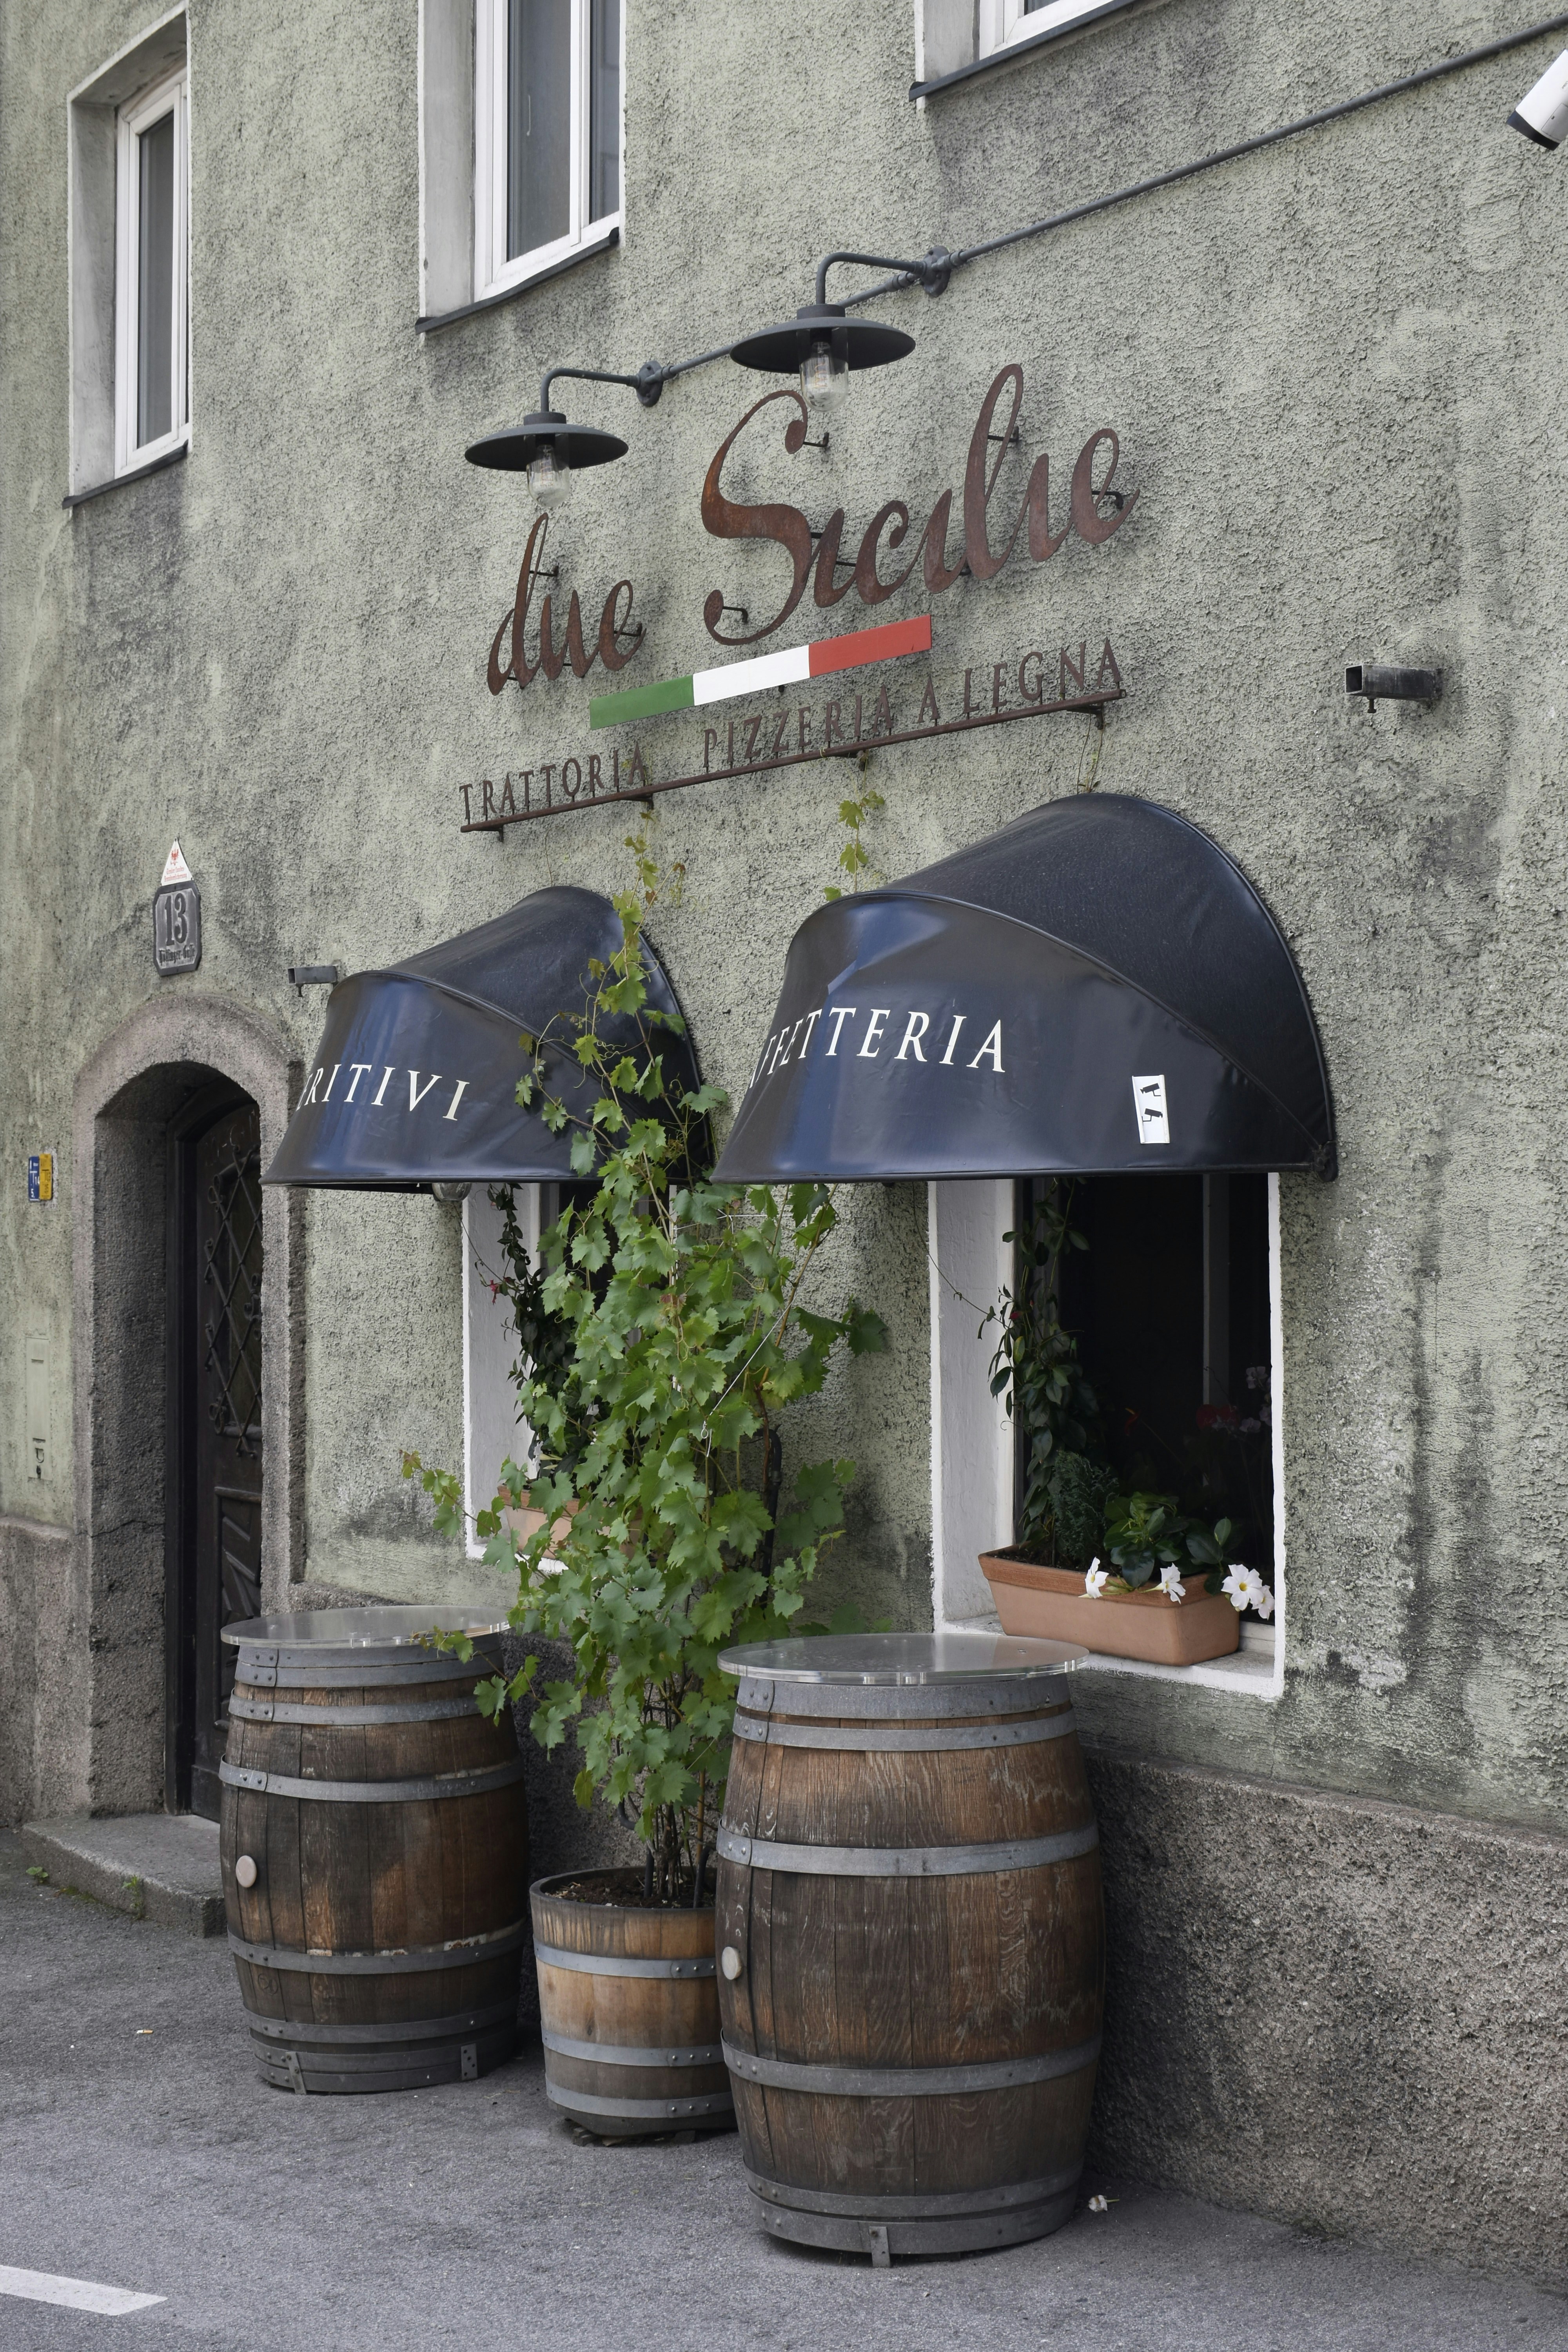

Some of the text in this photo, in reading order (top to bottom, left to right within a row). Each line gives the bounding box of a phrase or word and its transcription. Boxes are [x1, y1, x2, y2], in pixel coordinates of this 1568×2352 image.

[487, 512, 647, 695] due
[459, 637, 1122, 820] TRATTORIA PIZZERIA A LEGNA
[165, 893, 187, 946] 13
[750, 1007, 1005, 1088] FFETTERIA
